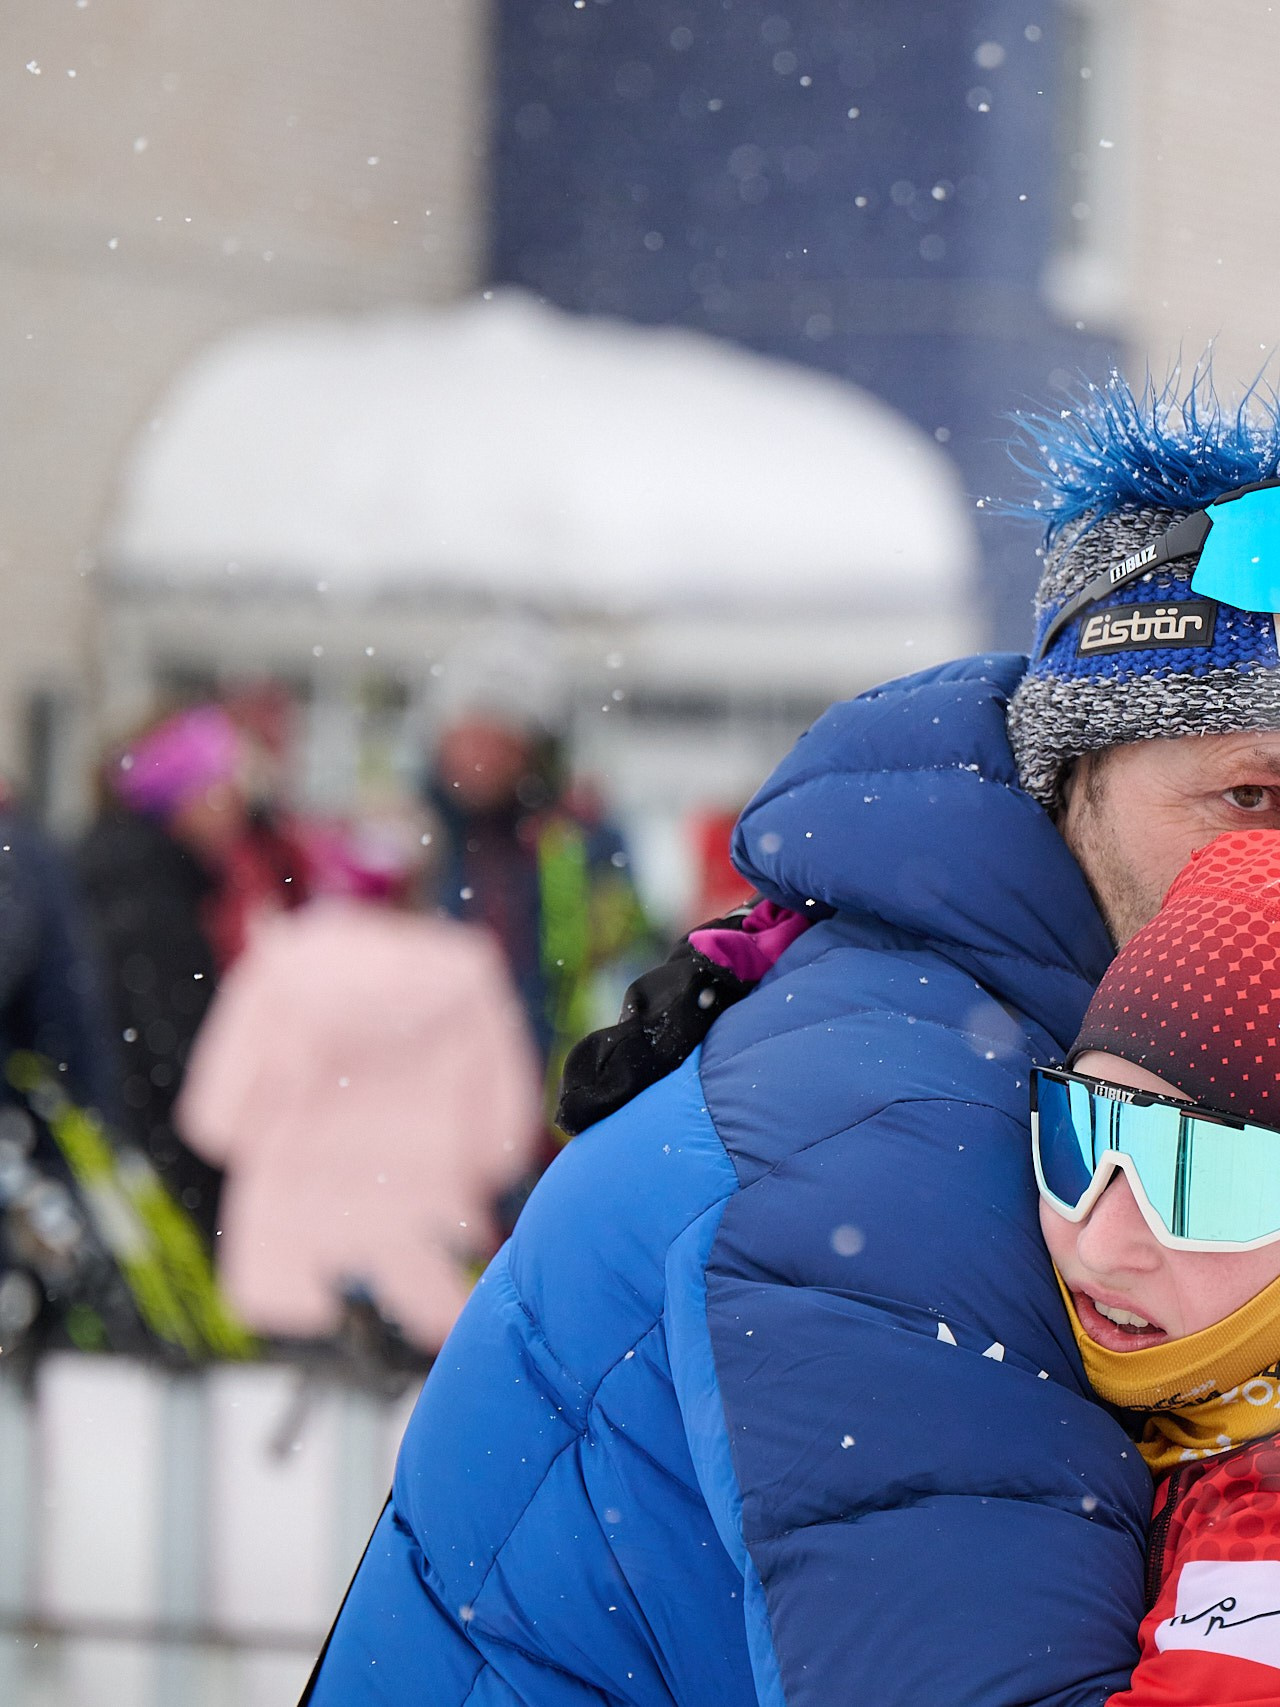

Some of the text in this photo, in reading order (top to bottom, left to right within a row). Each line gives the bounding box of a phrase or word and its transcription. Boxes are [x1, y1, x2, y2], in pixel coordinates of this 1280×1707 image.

[1125, 544, 1157, 576] BLIZ
[1080, 608, 1203, 650] Eisbär
[1108, 1087, 1136, 1104] BLIZ
